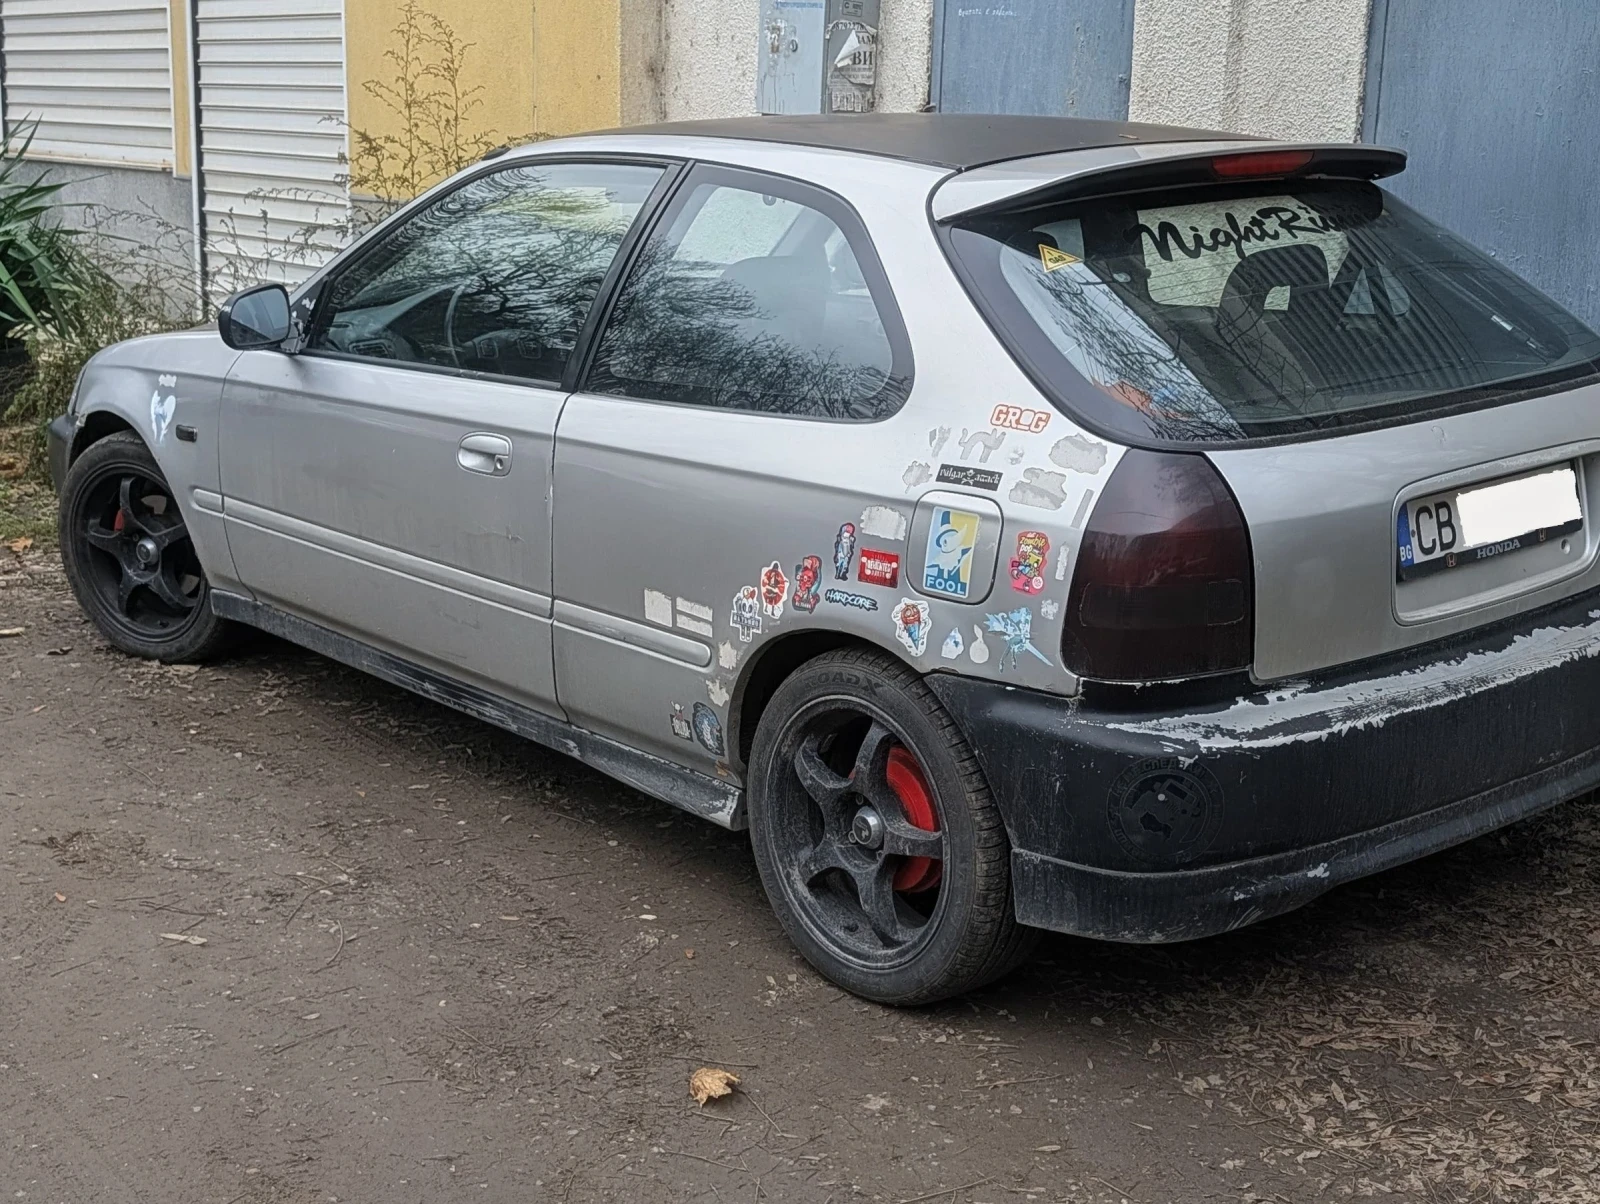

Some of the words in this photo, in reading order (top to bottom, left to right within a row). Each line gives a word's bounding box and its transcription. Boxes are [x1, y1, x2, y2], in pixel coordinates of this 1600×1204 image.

[1414, 500, 1457, 556] CB
[1400, 545, 1413, 562] BG
[1476, 538, 1521, 559] HONDA
[926, 576, 965, 595] FOOL
[826, 589, 878, 611] HARDCORE
